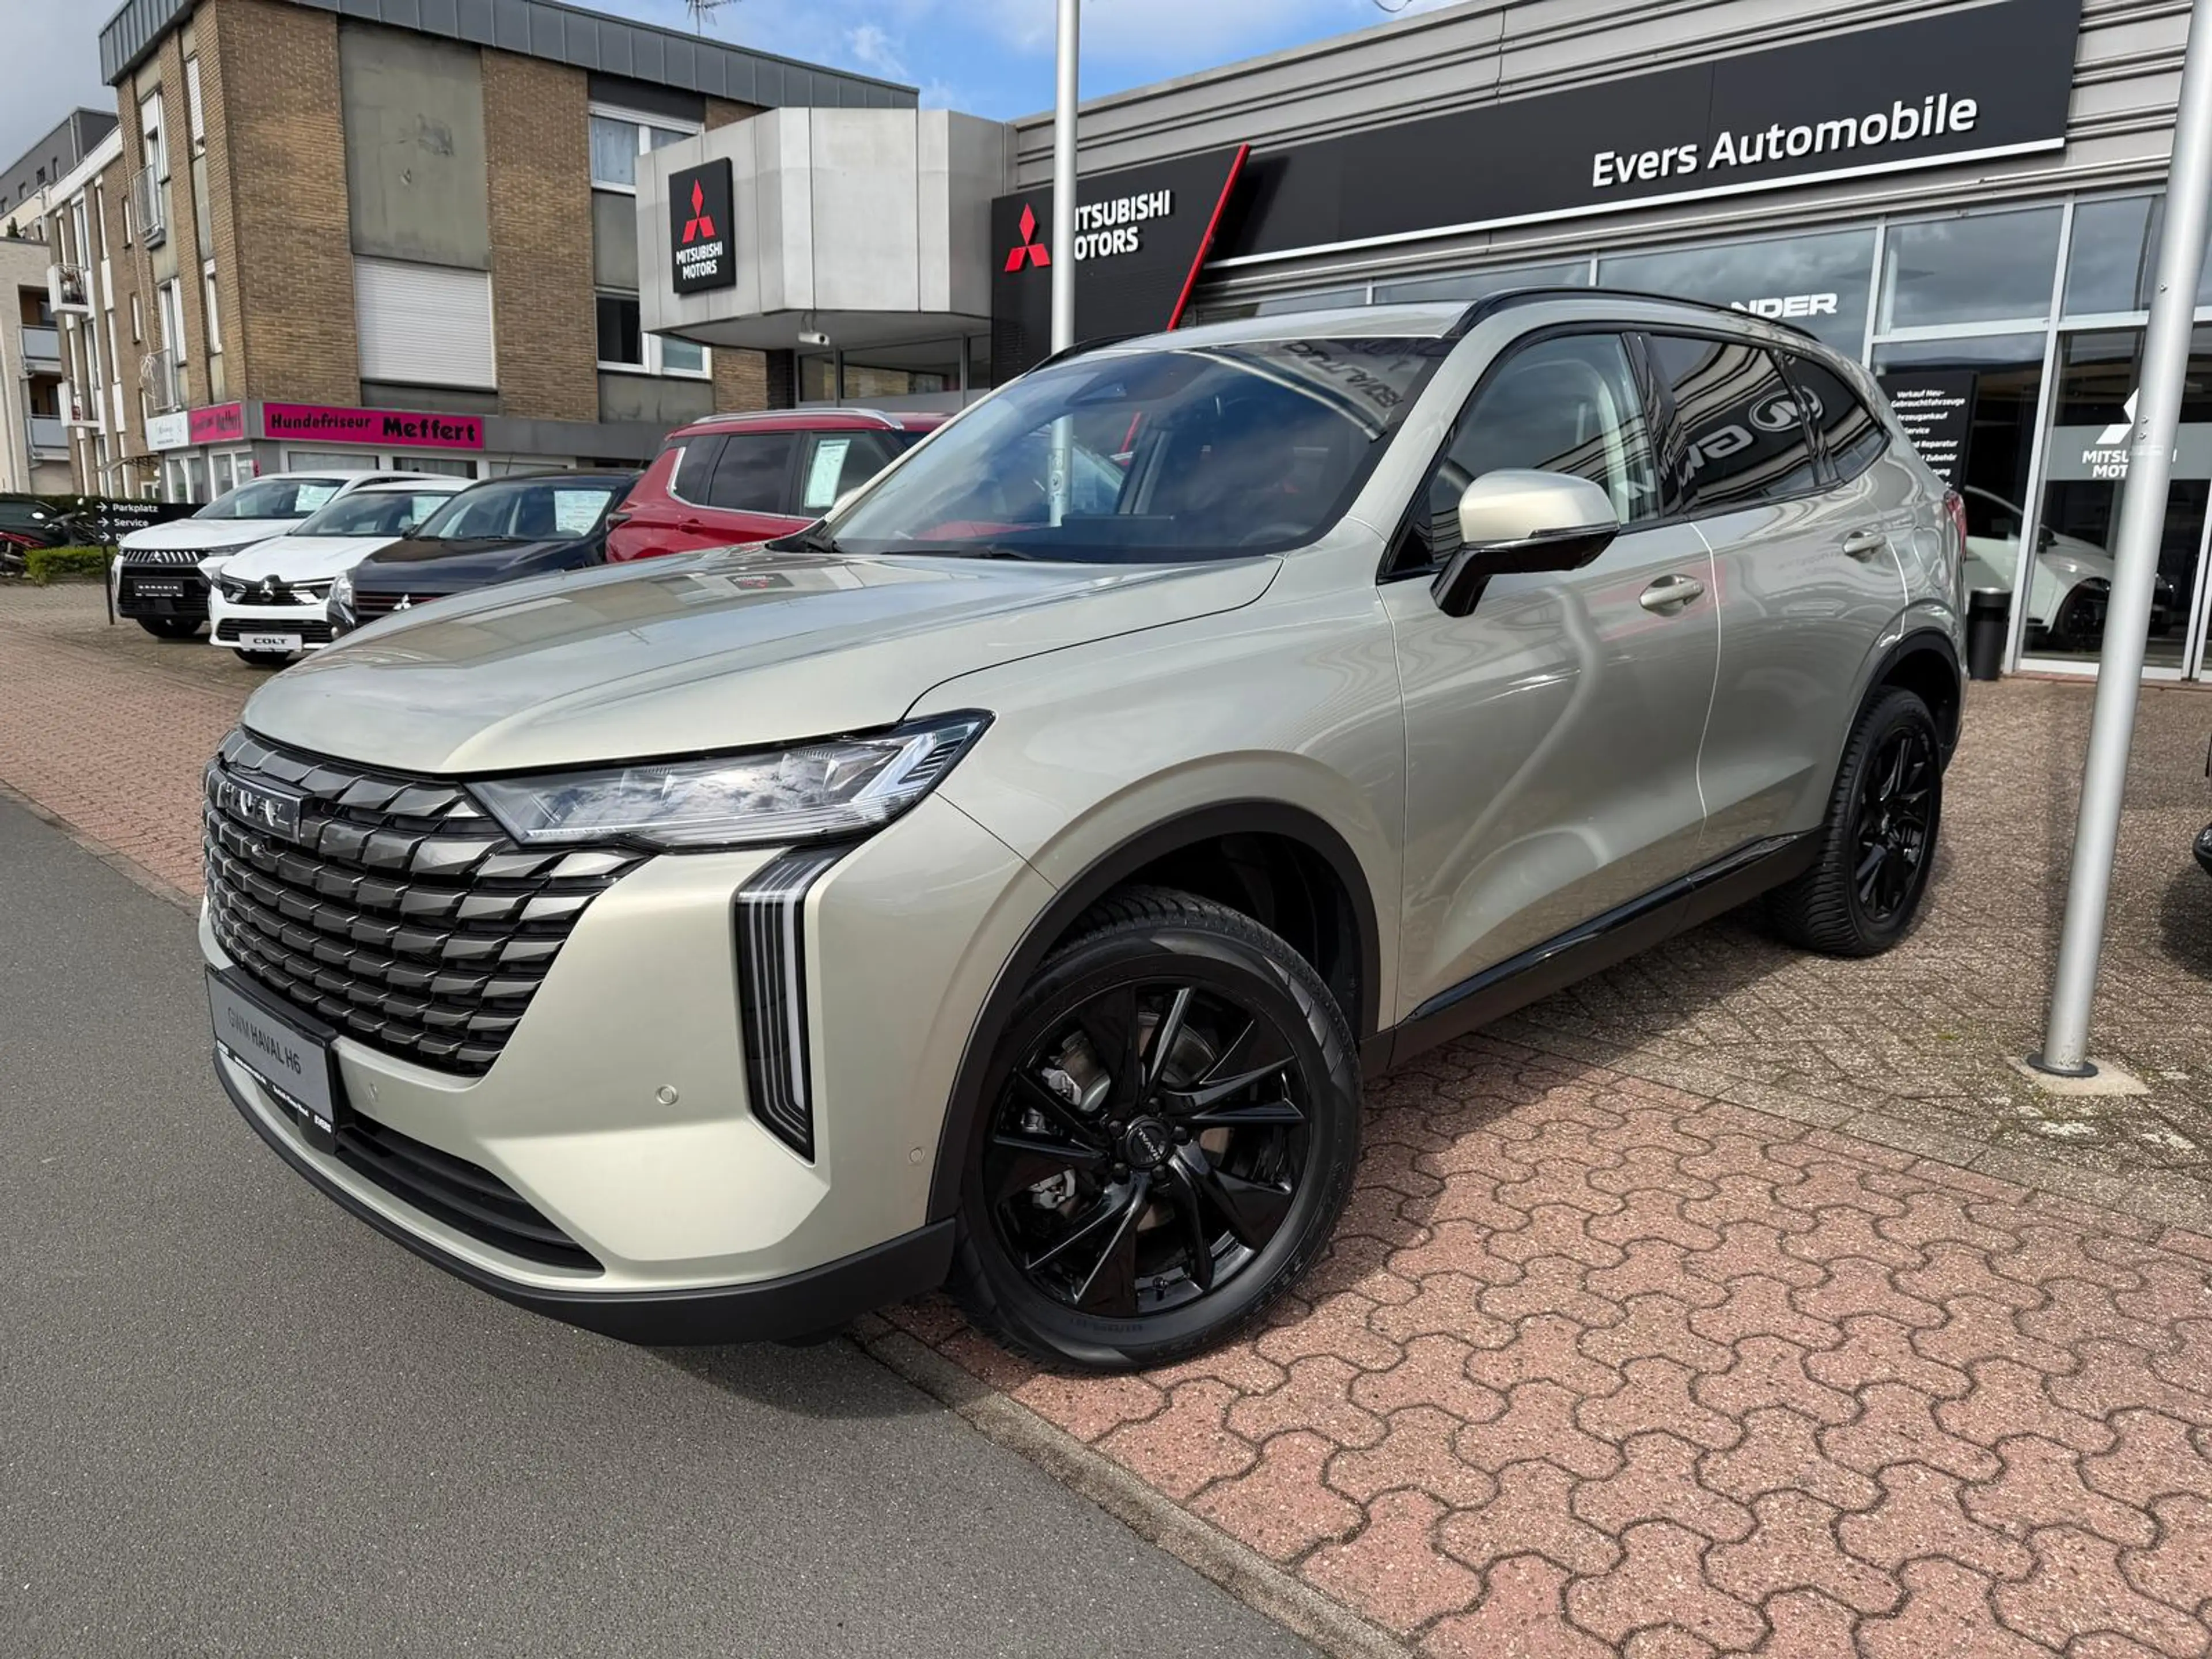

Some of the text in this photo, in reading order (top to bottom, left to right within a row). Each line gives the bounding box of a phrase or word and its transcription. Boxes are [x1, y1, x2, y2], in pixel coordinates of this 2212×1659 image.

[1593, 93, 1978, 187] Evers Automobile
[1075, 190, 1171, 231] ITSUBISHI
[676, 241, 722, 265] MITSUBISHI
[1075, 226, 1138, 261] OTORS
[683, 260, 717, 280] MOTORS
[1730, 293, 1838, 319] NDER
[1891, 398, 1965, 407] Gebrauchtfahrzeuge
[271, 413, 476, 442] Hundefriseur Meffert
[1921, 440, 1958, 449] Reparatur
[1926, 453, 1957, 461] Zubehör
[2092, 464, 2129, 478] MOT
[113, 503, 158, 513] Parkplatz
[114, 518, 149, 527] Service
[250, 1022, 285, 1065] HAVAL
[285, 1046, 301, 1075] H6
